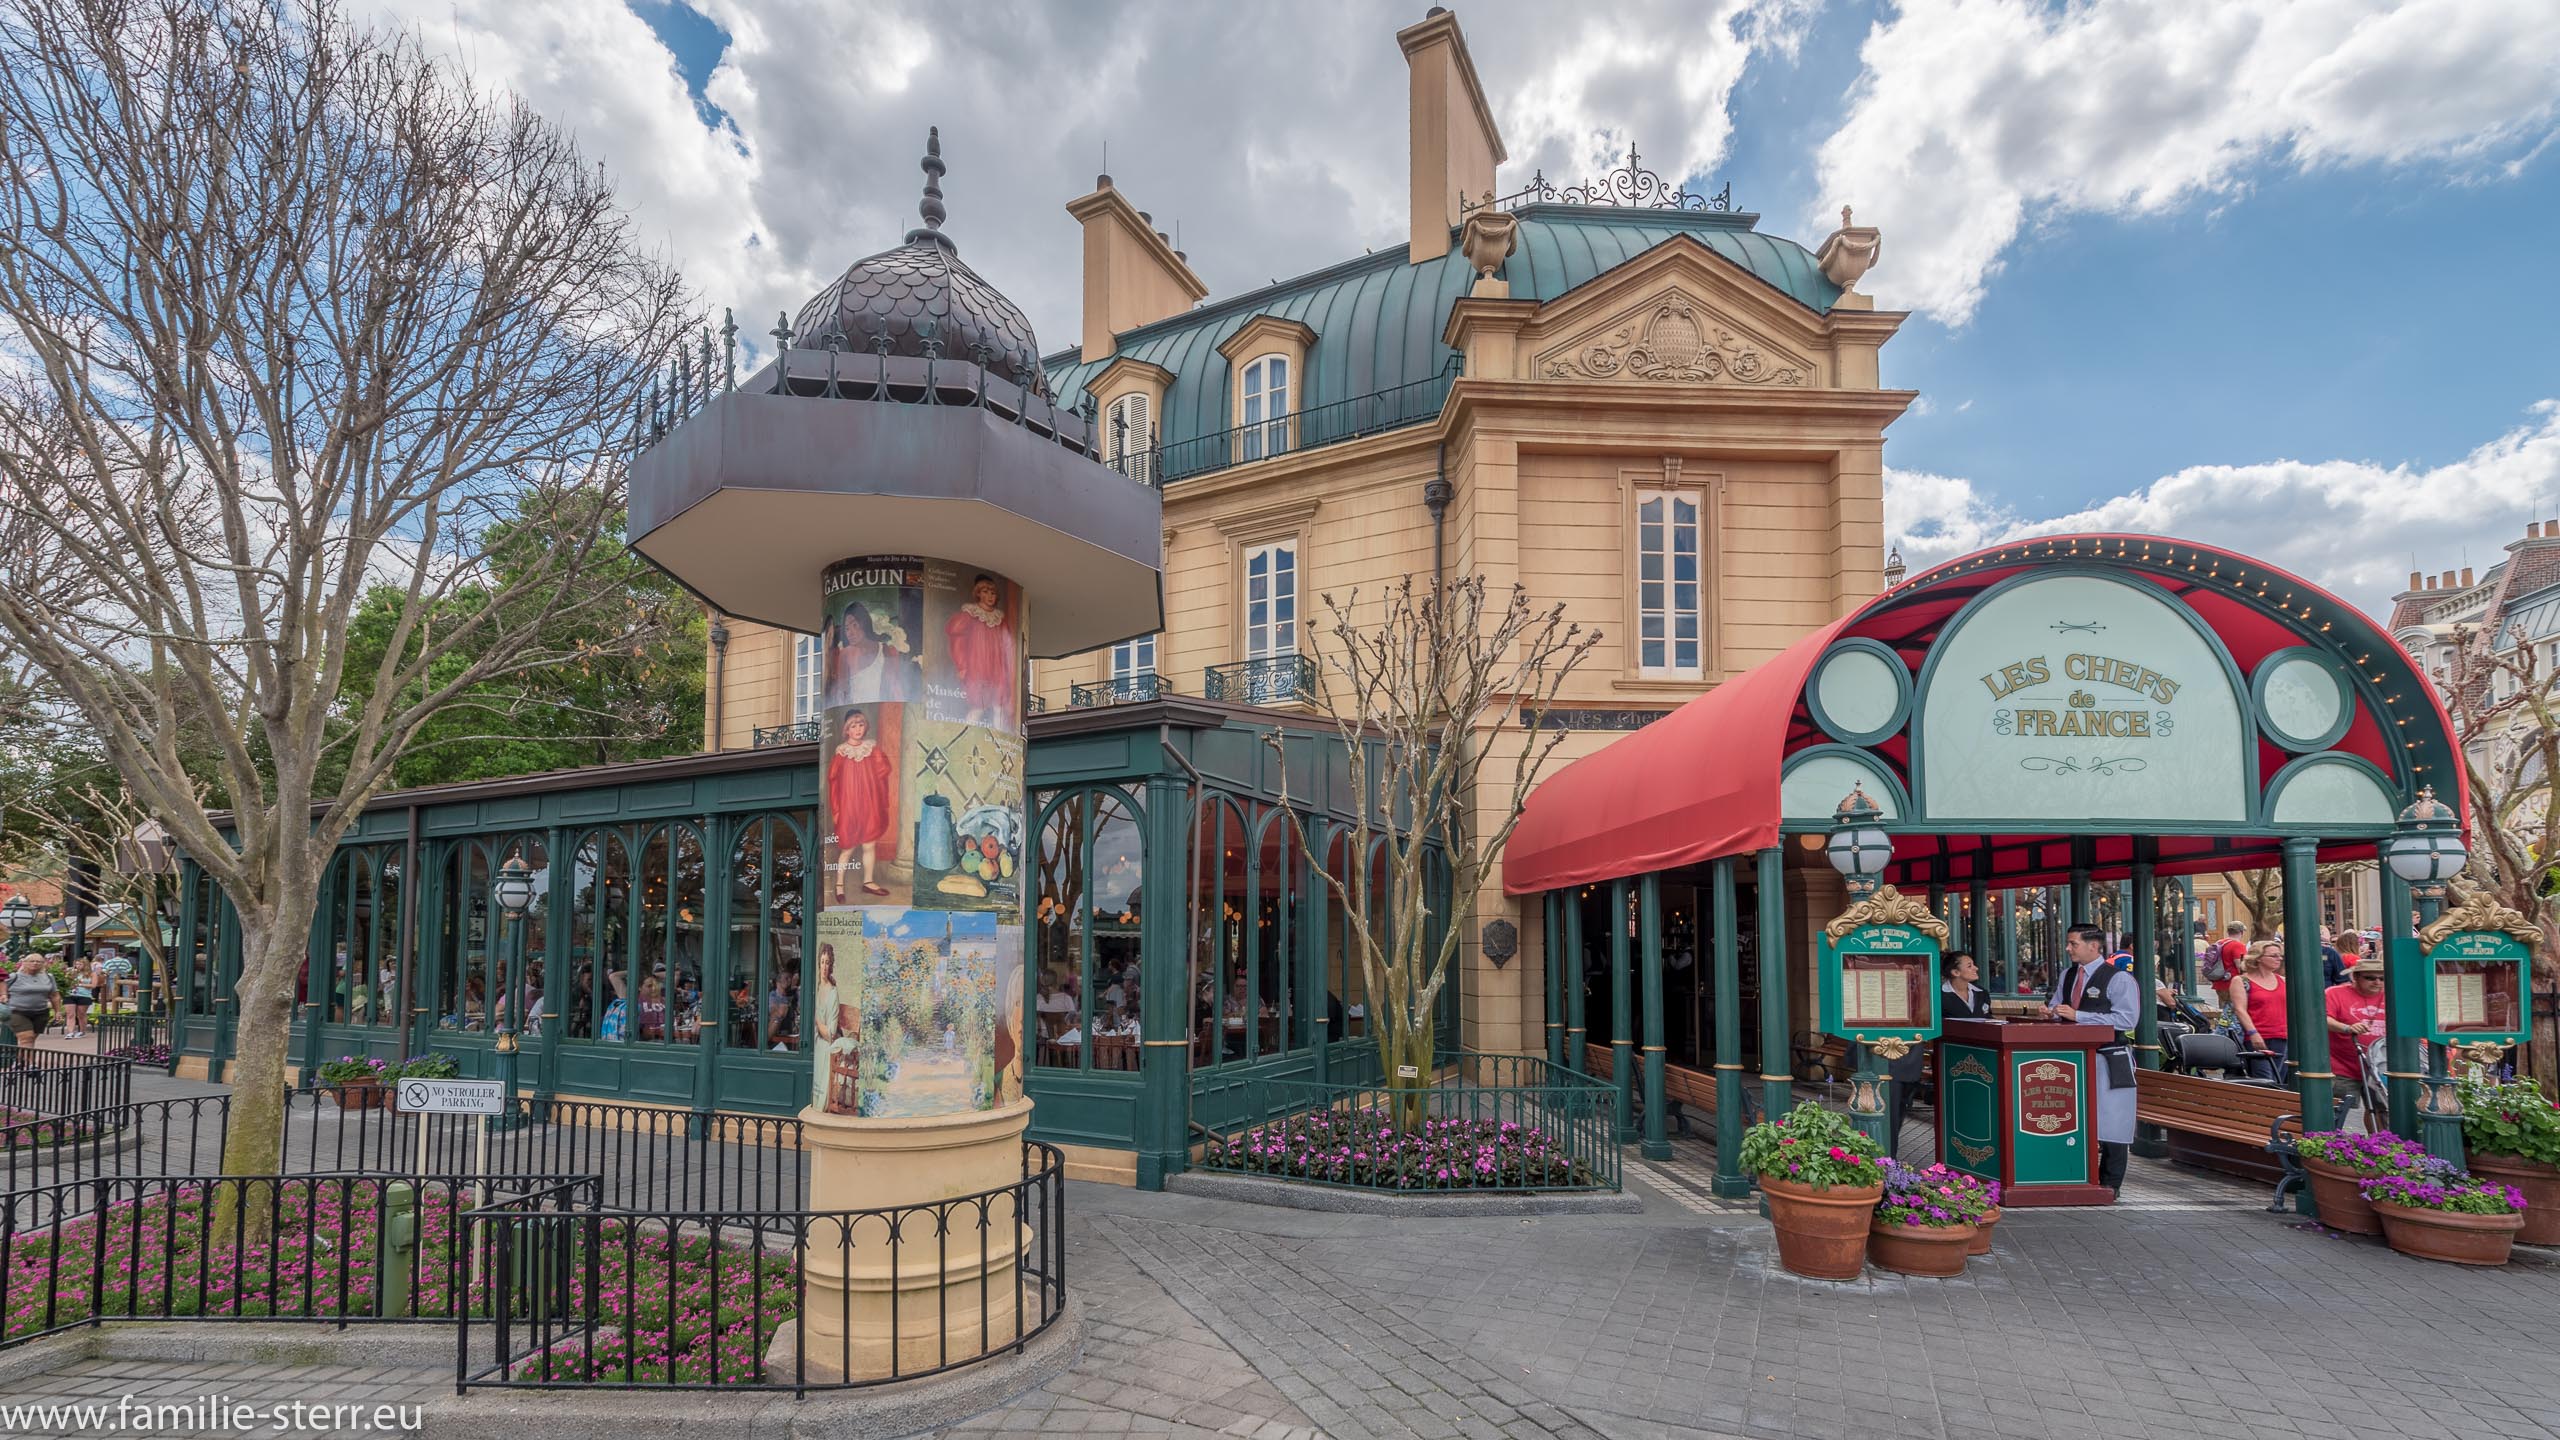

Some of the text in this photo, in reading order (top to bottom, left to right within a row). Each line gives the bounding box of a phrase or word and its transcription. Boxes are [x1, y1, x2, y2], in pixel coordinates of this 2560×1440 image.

[824, 569, 904, 595] GAUGUIN
[1980, 653, 2181, 705] LES CHEFS
[927, 684, 968, 699] Musée
[2068, 690, 2096, 708] de
[1568, 711, 1602, 724] Les
[2015, 710, 2151, 738] FRANCE
[432, 1087, 495, 1098] NO STROLLER
[441, 1098, 484, 1108] PARKING
